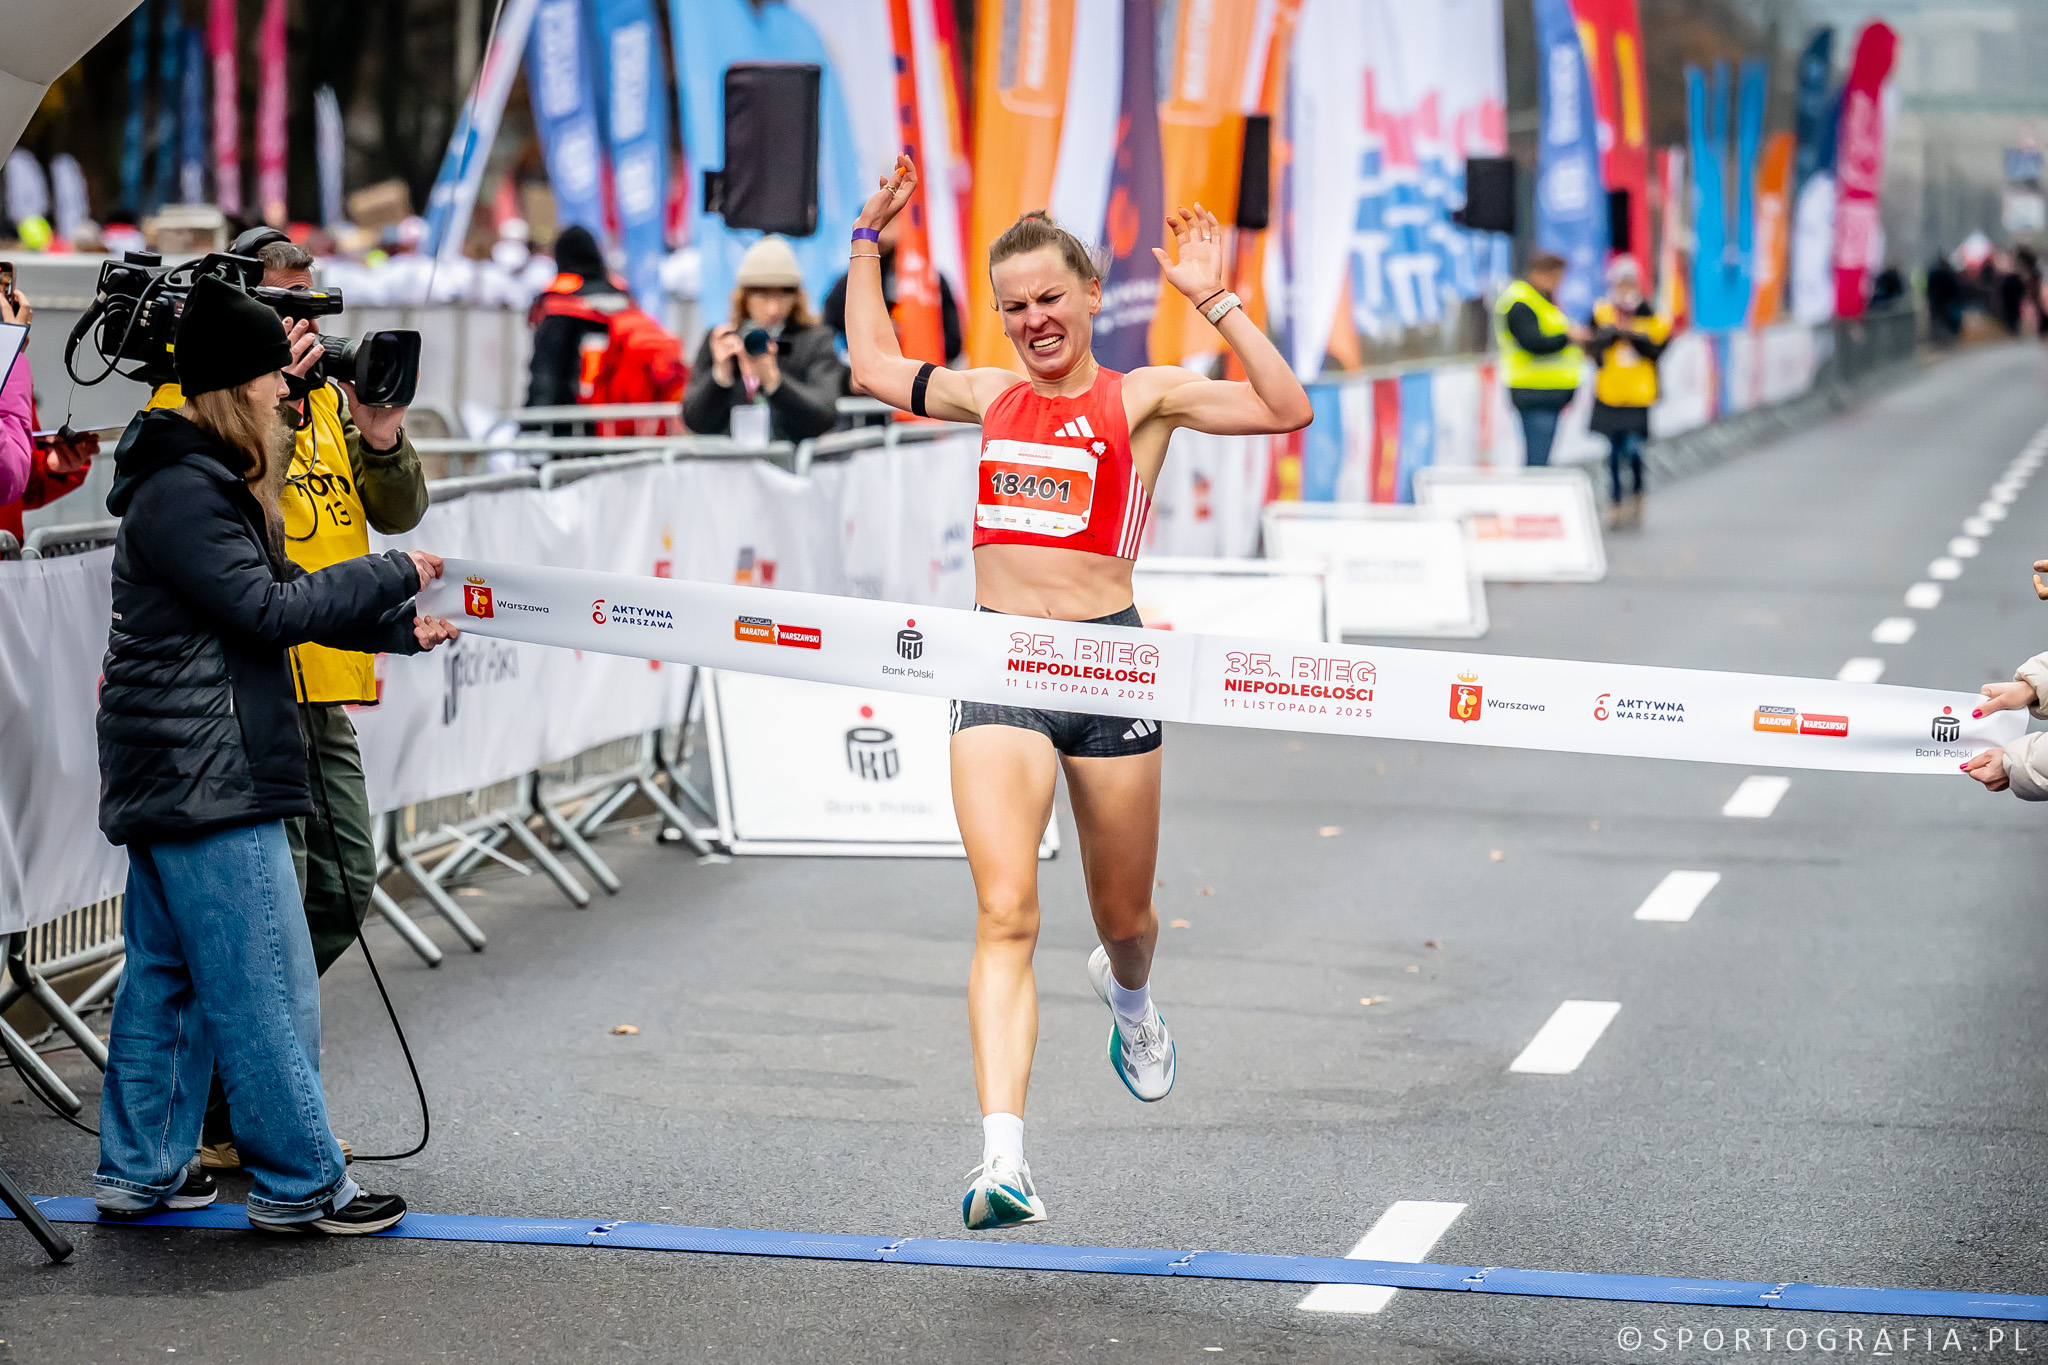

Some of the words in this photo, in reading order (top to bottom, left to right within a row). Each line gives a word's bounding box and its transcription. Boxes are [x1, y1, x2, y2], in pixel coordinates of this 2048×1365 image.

[991, 472, 1071, 503] 18401
[325, 501, 352, 526] 13
[496, 599, 550, 614] Warszawa
[611, 604, 674, 620] AKTYWNA
[611, 615, 674, 630] WARSZAWA
[740, 616, 771, 626] FUNDACJA
[739, 626, 769, 638] MARATON
[780, 631, 820, 643] WARSZAWSKI
[1007, 631, 1064, 660] 35.
[1074, 638, 1160, 668] BIEG
[882, 665, 906, 676] Bank
[907, 667, 934, 680] Polski
[1007, 658, 1156, 685] NIEPODLEGŁOŚCI
[1224, 651, 1281, 678] 35.
[1291, 656, 1377, 685] BIEG
[1006, 678, 1018, 687] 11
[1026, 679, 1109, 697] LISTOPADA
[1118, 689, 1154, 700] 2025
[1224, 678, 1374, 702] NIEPODLEGŁOŚCI
[1223, 698, 1235, 707] 11
[1243, 699, 1327, 714] LISTOPADA
[1336, 706, 1372, 718] 2025
[1487, 698, 1546, 712] Warszawa
[1616, 698, 1685, 712] AKTYWNA
[1760, 706, 1794, 714] FUNDACJA
[1616, 710, 1684, 723] WARSZAWA
[1758, 716, 1791, 727] MARATON
[1803, 720, 1847, 731] WARSZAWSKI
[1915, 748, 1942, 758] Bank
[1943, 749, 1973, 759] Polski
